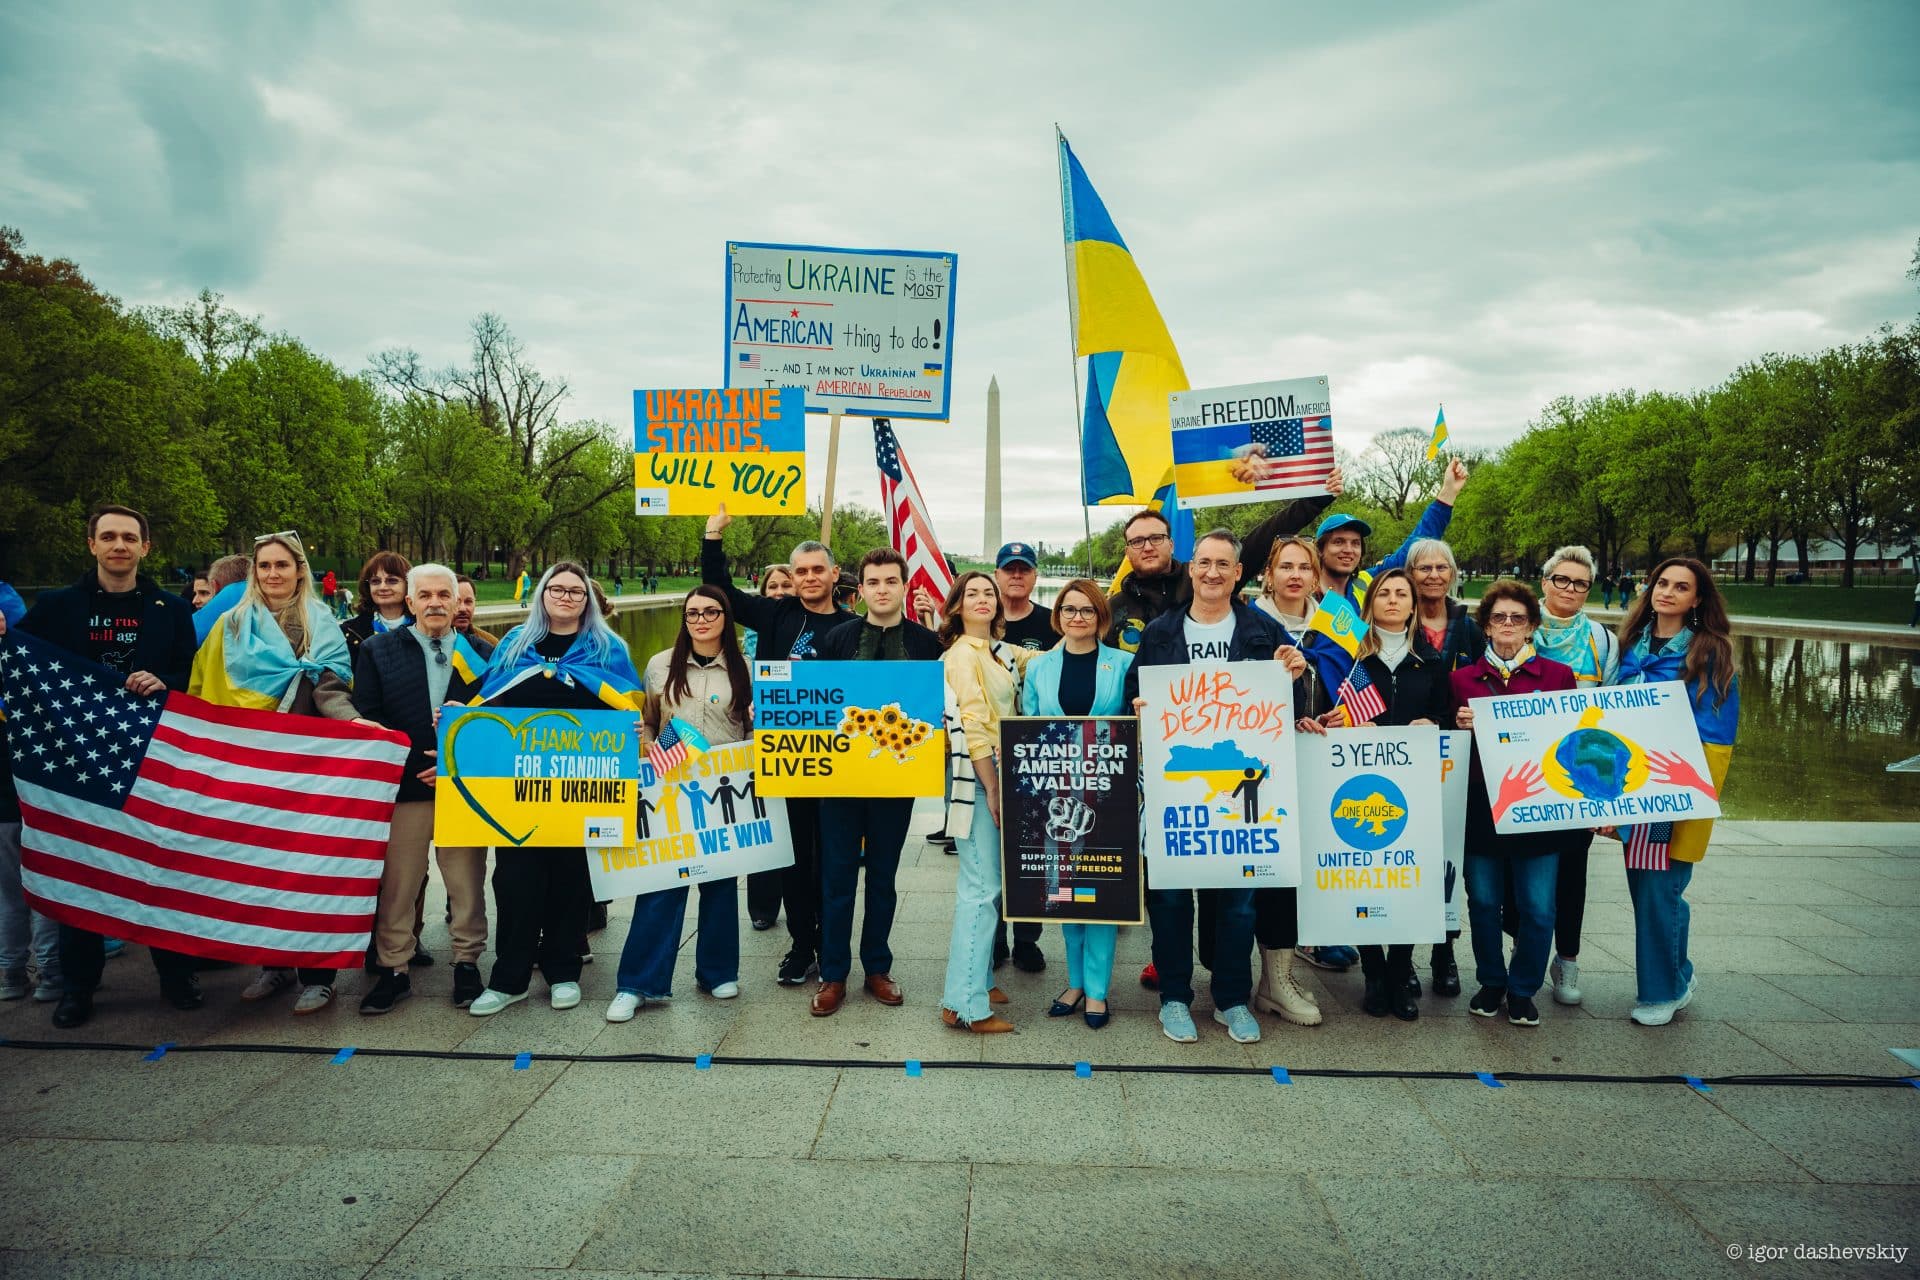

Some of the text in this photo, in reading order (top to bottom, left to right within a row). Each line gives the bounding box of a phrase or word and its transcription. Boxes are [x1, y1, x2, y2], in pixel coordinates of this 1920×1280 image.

[733, 258, 944, 296] Protecting UKRAINE is the
[903, 282, 945, 298] MOST
[733, 302, 833, 345] AMERICAN
[842, 323, 881, 353] thing
[889, 325, 905, 350] to
[782, 363, 801, 375] AND
[805, 362, 813, 375] I
[817, 365, 830, 375] AM
[834, 366, 855, 376] NOT
[816, 380, 872, 396] AMERICAN
[645, 388, 782, 421] UKRAINE
[1171, 394, 1331, 429] UKRAINE FREEDOM AMERICA
[650, 452, 802, 506] WILL YOU?
[760, 688, 845, 705] HELPING
[1169, 670, 1251, 706] WAR
[761, 710, 837, 726] PEOPLE
[1492, 695, 1557, 719] FREEDOM
[1560, 694, 1588, 713] FOR
[518, 727, 626, 752] THANK YOU
[760, 733, 850, 754] SAVING
[1013, 743, 1128, 759] STAND FOR
[1331, 741, 1413, 767] 3 YEARS.
[514, 754, 620, 779] FOR STANDING
[761, 757, 833, 777] LIVES
[1017, 760, 1124, 775] AMERICAN
[514, 779, 626, 803] WITH UKRAINE!
[1030, 776, 1111, 791] VALUES
[1163, 805, 1210, 829] AID
[1342, 805, 1399, 818] ONE CAUSE.
[1512, 792, 1694, 824] SECURITY FOR THE WORLD!
[598, 819, 774, 873] TOGETHER WE WIN
[1164, 828, 1280, 857] RESTORES
[1021, 853, 1122, 863] SUPPORT UKRAINE'S
[1053, 864, 1073, 872] FOR
[1075, 865, 1123, 873] FREEDOM
[1317, 849, 1416, 867] UNITED FOR
[1315, 867, 1421, 890] UKRAINE!
